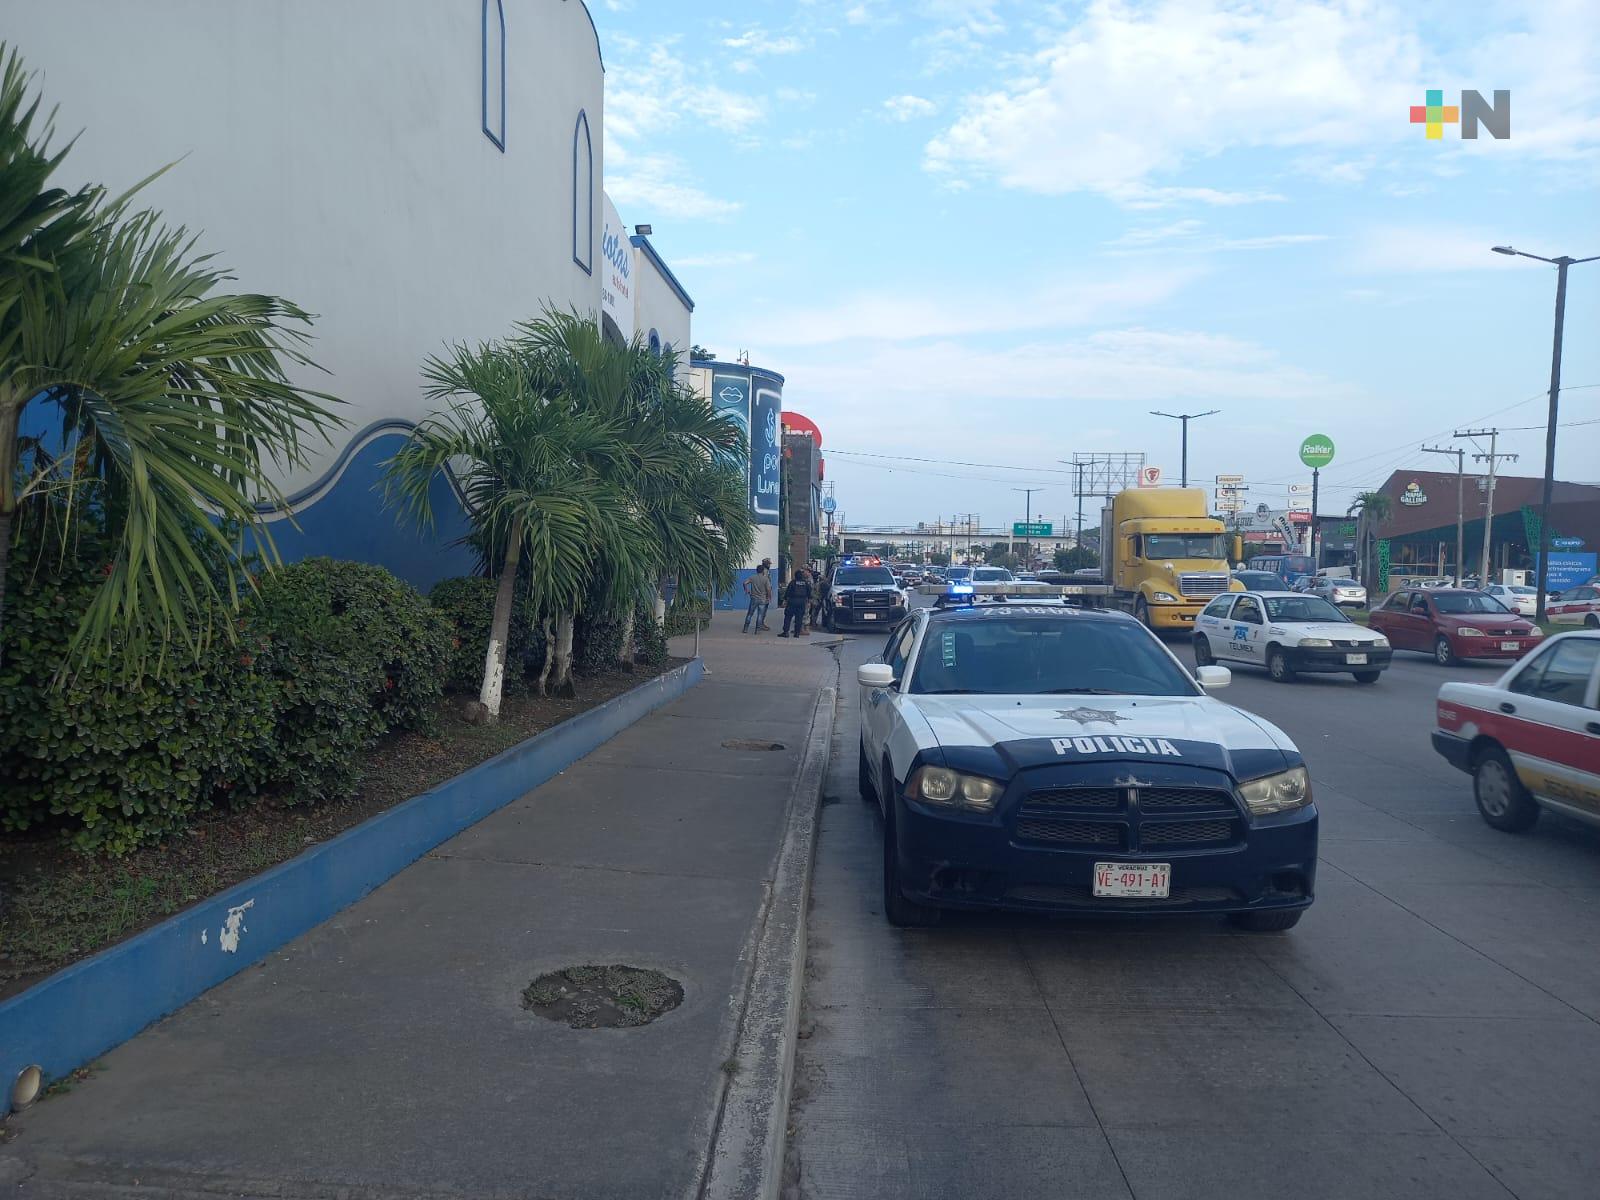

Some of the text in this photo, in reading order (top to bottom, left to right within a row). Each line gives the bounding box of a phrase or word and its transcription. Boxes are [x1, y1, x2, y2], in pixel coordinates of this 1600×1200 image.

[1228, 642, 1254, 653] TELMEX
[1050, 736, 1183, 757] POLICIA
[1097, 872, 1166, 888] VE-491-A1
